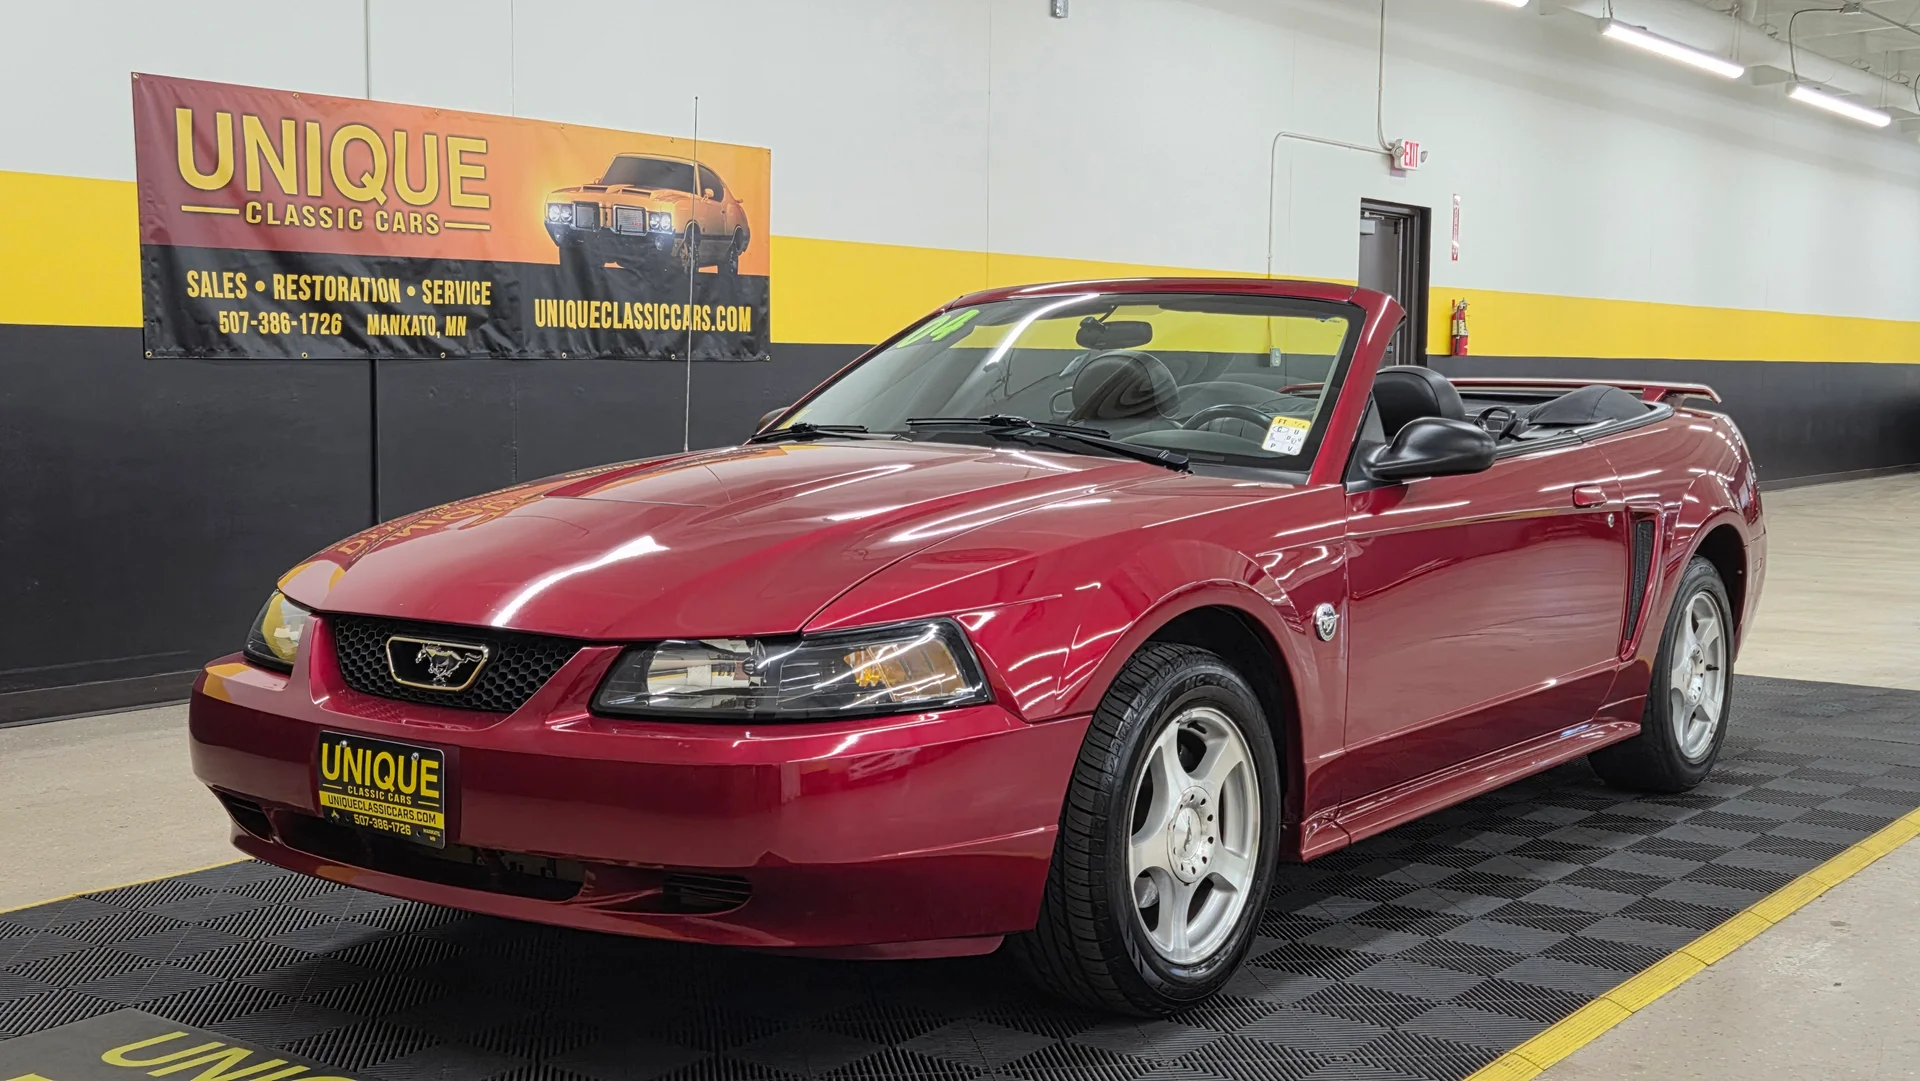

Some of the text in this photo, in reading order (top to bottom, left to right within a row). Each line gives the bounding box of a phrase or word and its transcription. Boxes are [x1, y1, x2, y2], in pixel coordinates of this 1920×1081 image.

[175, 107, 491, 209] UNIQUE
[1404, 140, 1420, 168] EXIT
[245, 201, 440, 235] CLASSIC CARS
[186, 270, 492, 306] SALES RESTORATION SERVICE
[218, 311, 467, 339] 507-386-1726 MANKATO, MN
[534, 298, 752, 333] UNIQUECLASSICCARS.COM
[321, 742, 440, 799] UNIQUE
[328, 794, 437, 825] UNIQUECLASSICCARS.COM
[347, 785, 412, 805] CLASSIC CARS
[354, 814, 412, 836] 507-386-1726
